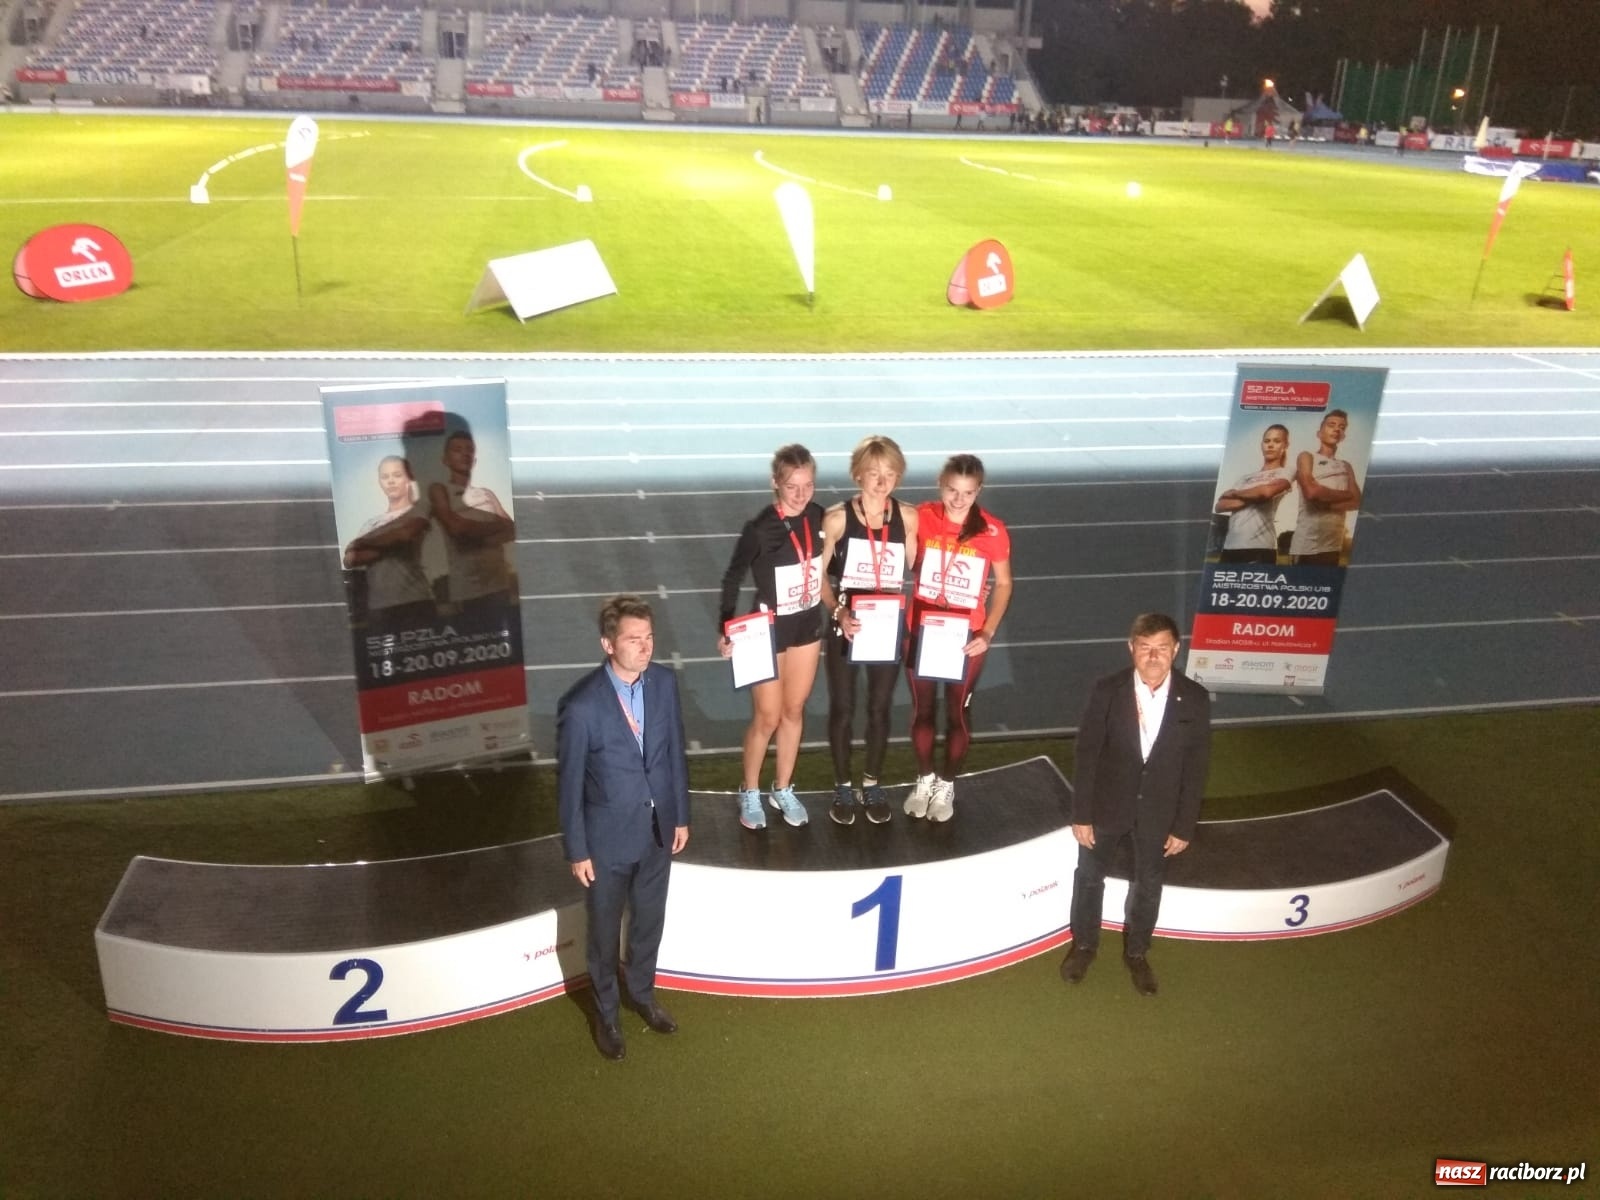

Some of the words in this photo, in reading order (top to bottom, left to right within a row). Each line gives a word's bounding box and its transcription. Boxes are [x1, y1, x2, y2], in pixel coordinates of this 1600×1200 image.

[61, 266, 109, 282] ORLEN
[1247, 385, 1296, 395] 52.PZLA
[1213, 571, 1288, 584] 52.PZLA
[1211, 583, 1278, 591] MISTRZOSTWA
[1280, 585, 1313, 593] POLSKI
[1210, 593, 1329, 610] 18-20.09.2020
[1232, 622, 1295, 637] RADOM
[369, 642, 512, 679] 18-20.09.2020
[408, 679, 484, 706] RADOM
[1285, 894, 1310, 927] 3
[851, 875, 903, 971] 1
[329, 958, 388, 1025] 2
